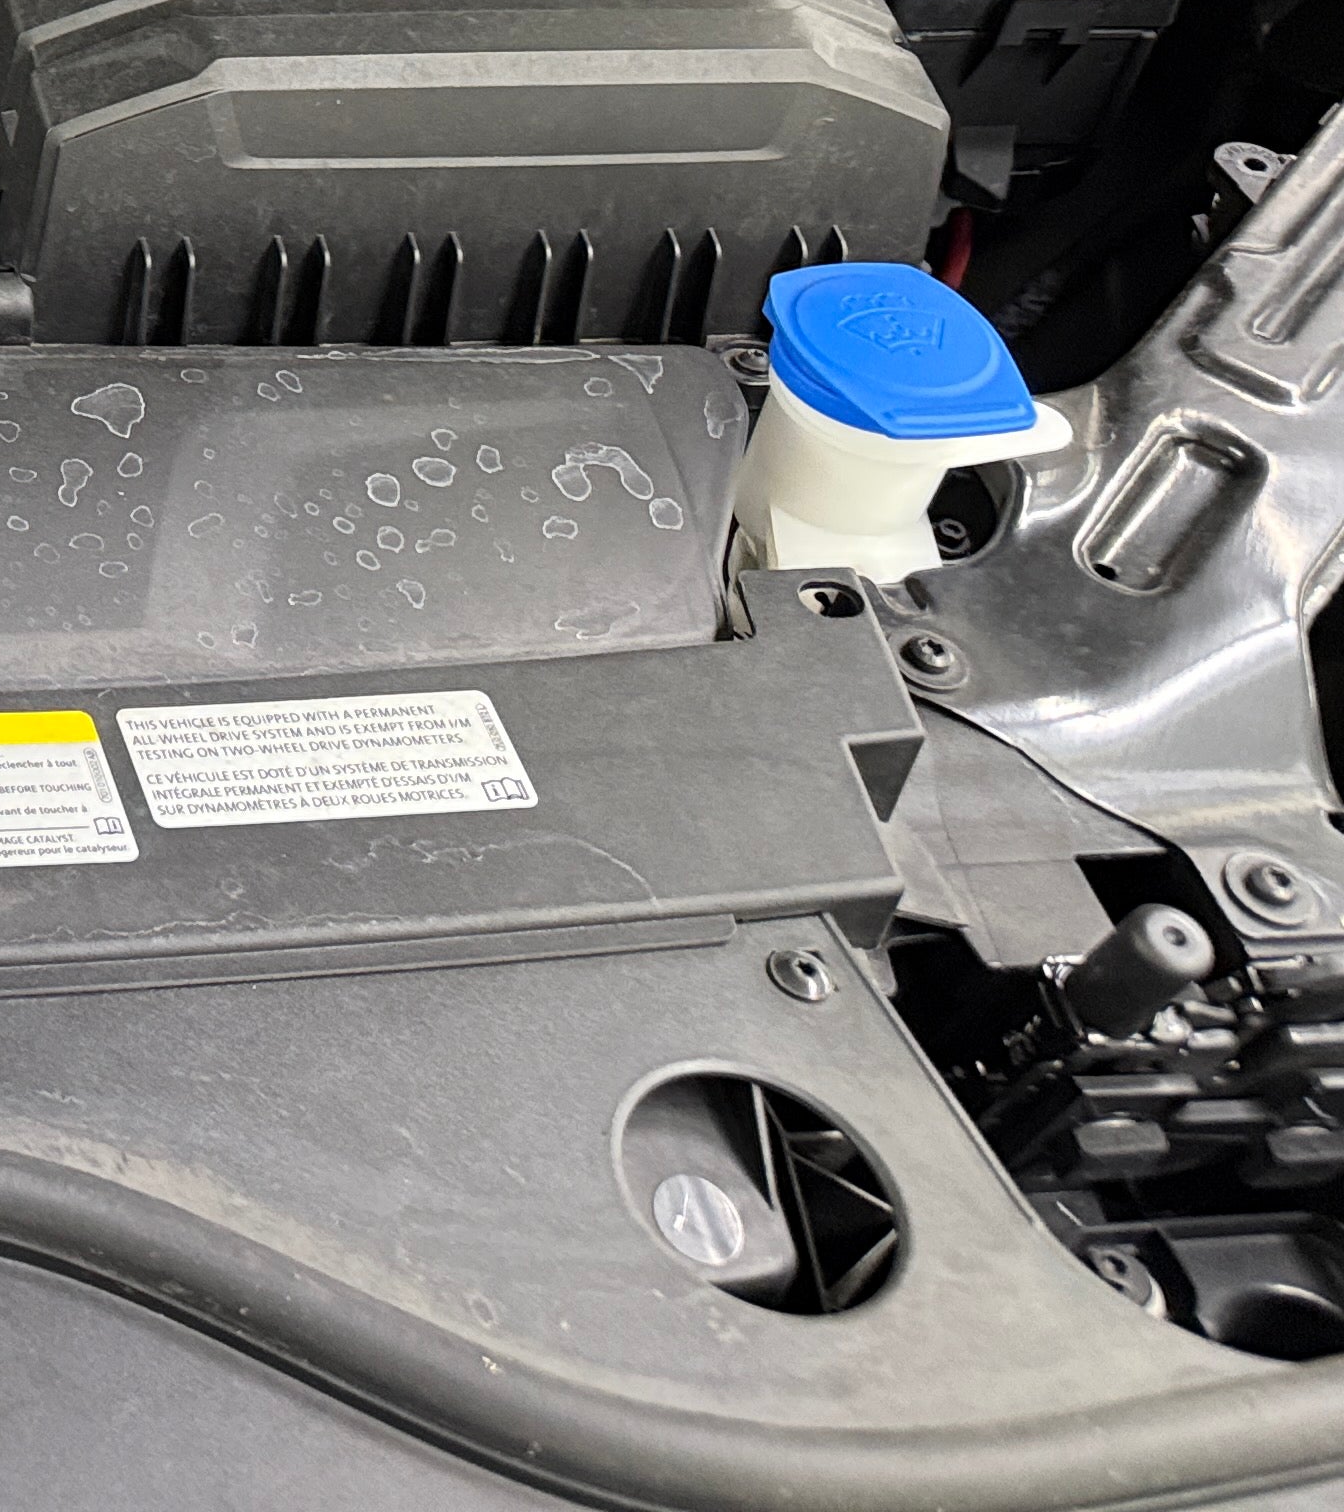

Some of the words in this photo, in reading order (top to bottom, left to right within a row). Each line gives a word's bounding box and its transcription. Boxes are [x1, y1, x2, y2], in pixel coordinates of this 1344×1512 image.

[126, 720, 157, 730] THIS
[159, 717, 216, 729] VEHICLE
[218, 717, 230, 726] IS
[233, 713, 300, 727] EQUIPPED
[302, 711, 339, 722] WITH
[343, 710, 353, 719] A
[354, 705, 435, 718] PERMANENT
[209, 730, 250, 742] DRIVE
[252, 728, 303, 740] SYSTEM
[306, 726, 336, 736] AND
[339, 725, 352, 734] IS
[354, 722, 404, 734] EXEMPT
[408, 719, 446, 731] FROM
[448, 718, 471, 728] I/M
[137, 748, 194, 760] TESTING
[197, 747, 219, 757] ON
[220, 743, 307, 756] TWO-WHEEL
[309, 740, 350, 751] DRIVE
[146, 774, 163, 784] CE
[164, 771, 230, 783] VÉHICULE
[232, 770, 254, 780] EST
[258, 765, 293, 779] DOTÉ
[295, 765, 330, 777] D'UN
[332, 761, 389, 775] SYSTÈME
[391, 761, 409, 771] DE
[409, 756, 508, 770] TRANSMISSION
[39, 783, 92, 792] TOUCHING
[152, 786, 222, 800] INTÉGRALE
[224, 783, 302, 796] PERMANENT
[305, 781, 320, 792] ET
[322, 776, 379, 790] EXEMPTÉ
[157, 804, 185, 815] SUR
[187, 798, 297, 814] DYNAMOMÈTRES
[300, 796, 310, 808] À
[312, 795, 349, 807] DEUX
[351, 792, 397, 805] ROUES
